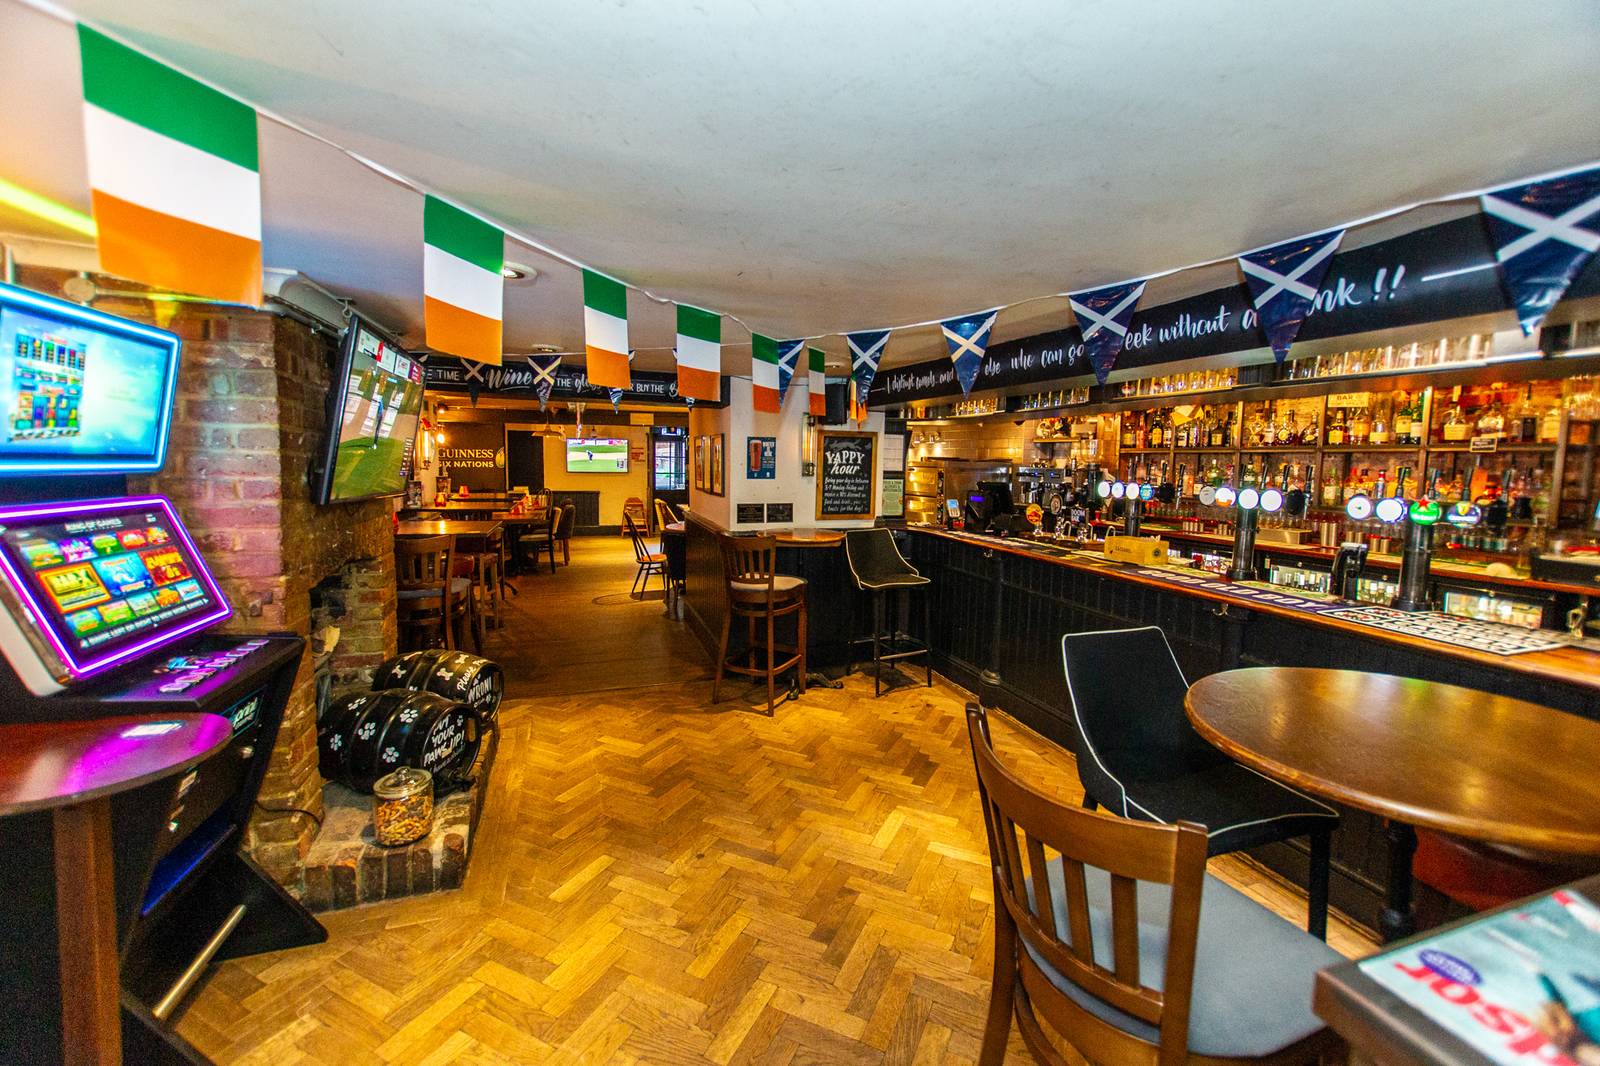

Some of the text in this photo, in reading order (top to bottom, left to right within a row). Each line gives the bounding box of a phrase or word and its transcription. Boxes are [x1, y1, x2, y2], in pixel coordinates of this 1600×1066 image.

[1011, 349, 1034, 371] who
[1041, 349, 1063, 368] can
[1068, 344, 1085, 366] go
[1124, 323, 1153, 350] eek
[1159, 305, 1231, 343] without
[437, 369, 459, 381] TIME
[486, 368, 532, 389] Wine
[557, 378, 571, 387] THE
[636, 383, 649, 392] BUY
[651, 384, 665, 393] THE
[439, 448, 494, 458] GUINNESS
[825, 450, 865, 464] YAPPY
[830, 462, 860, 475] hour
[1251, 594, 1329, 608] BOY
[432, 725, 455, 748] YOUR
